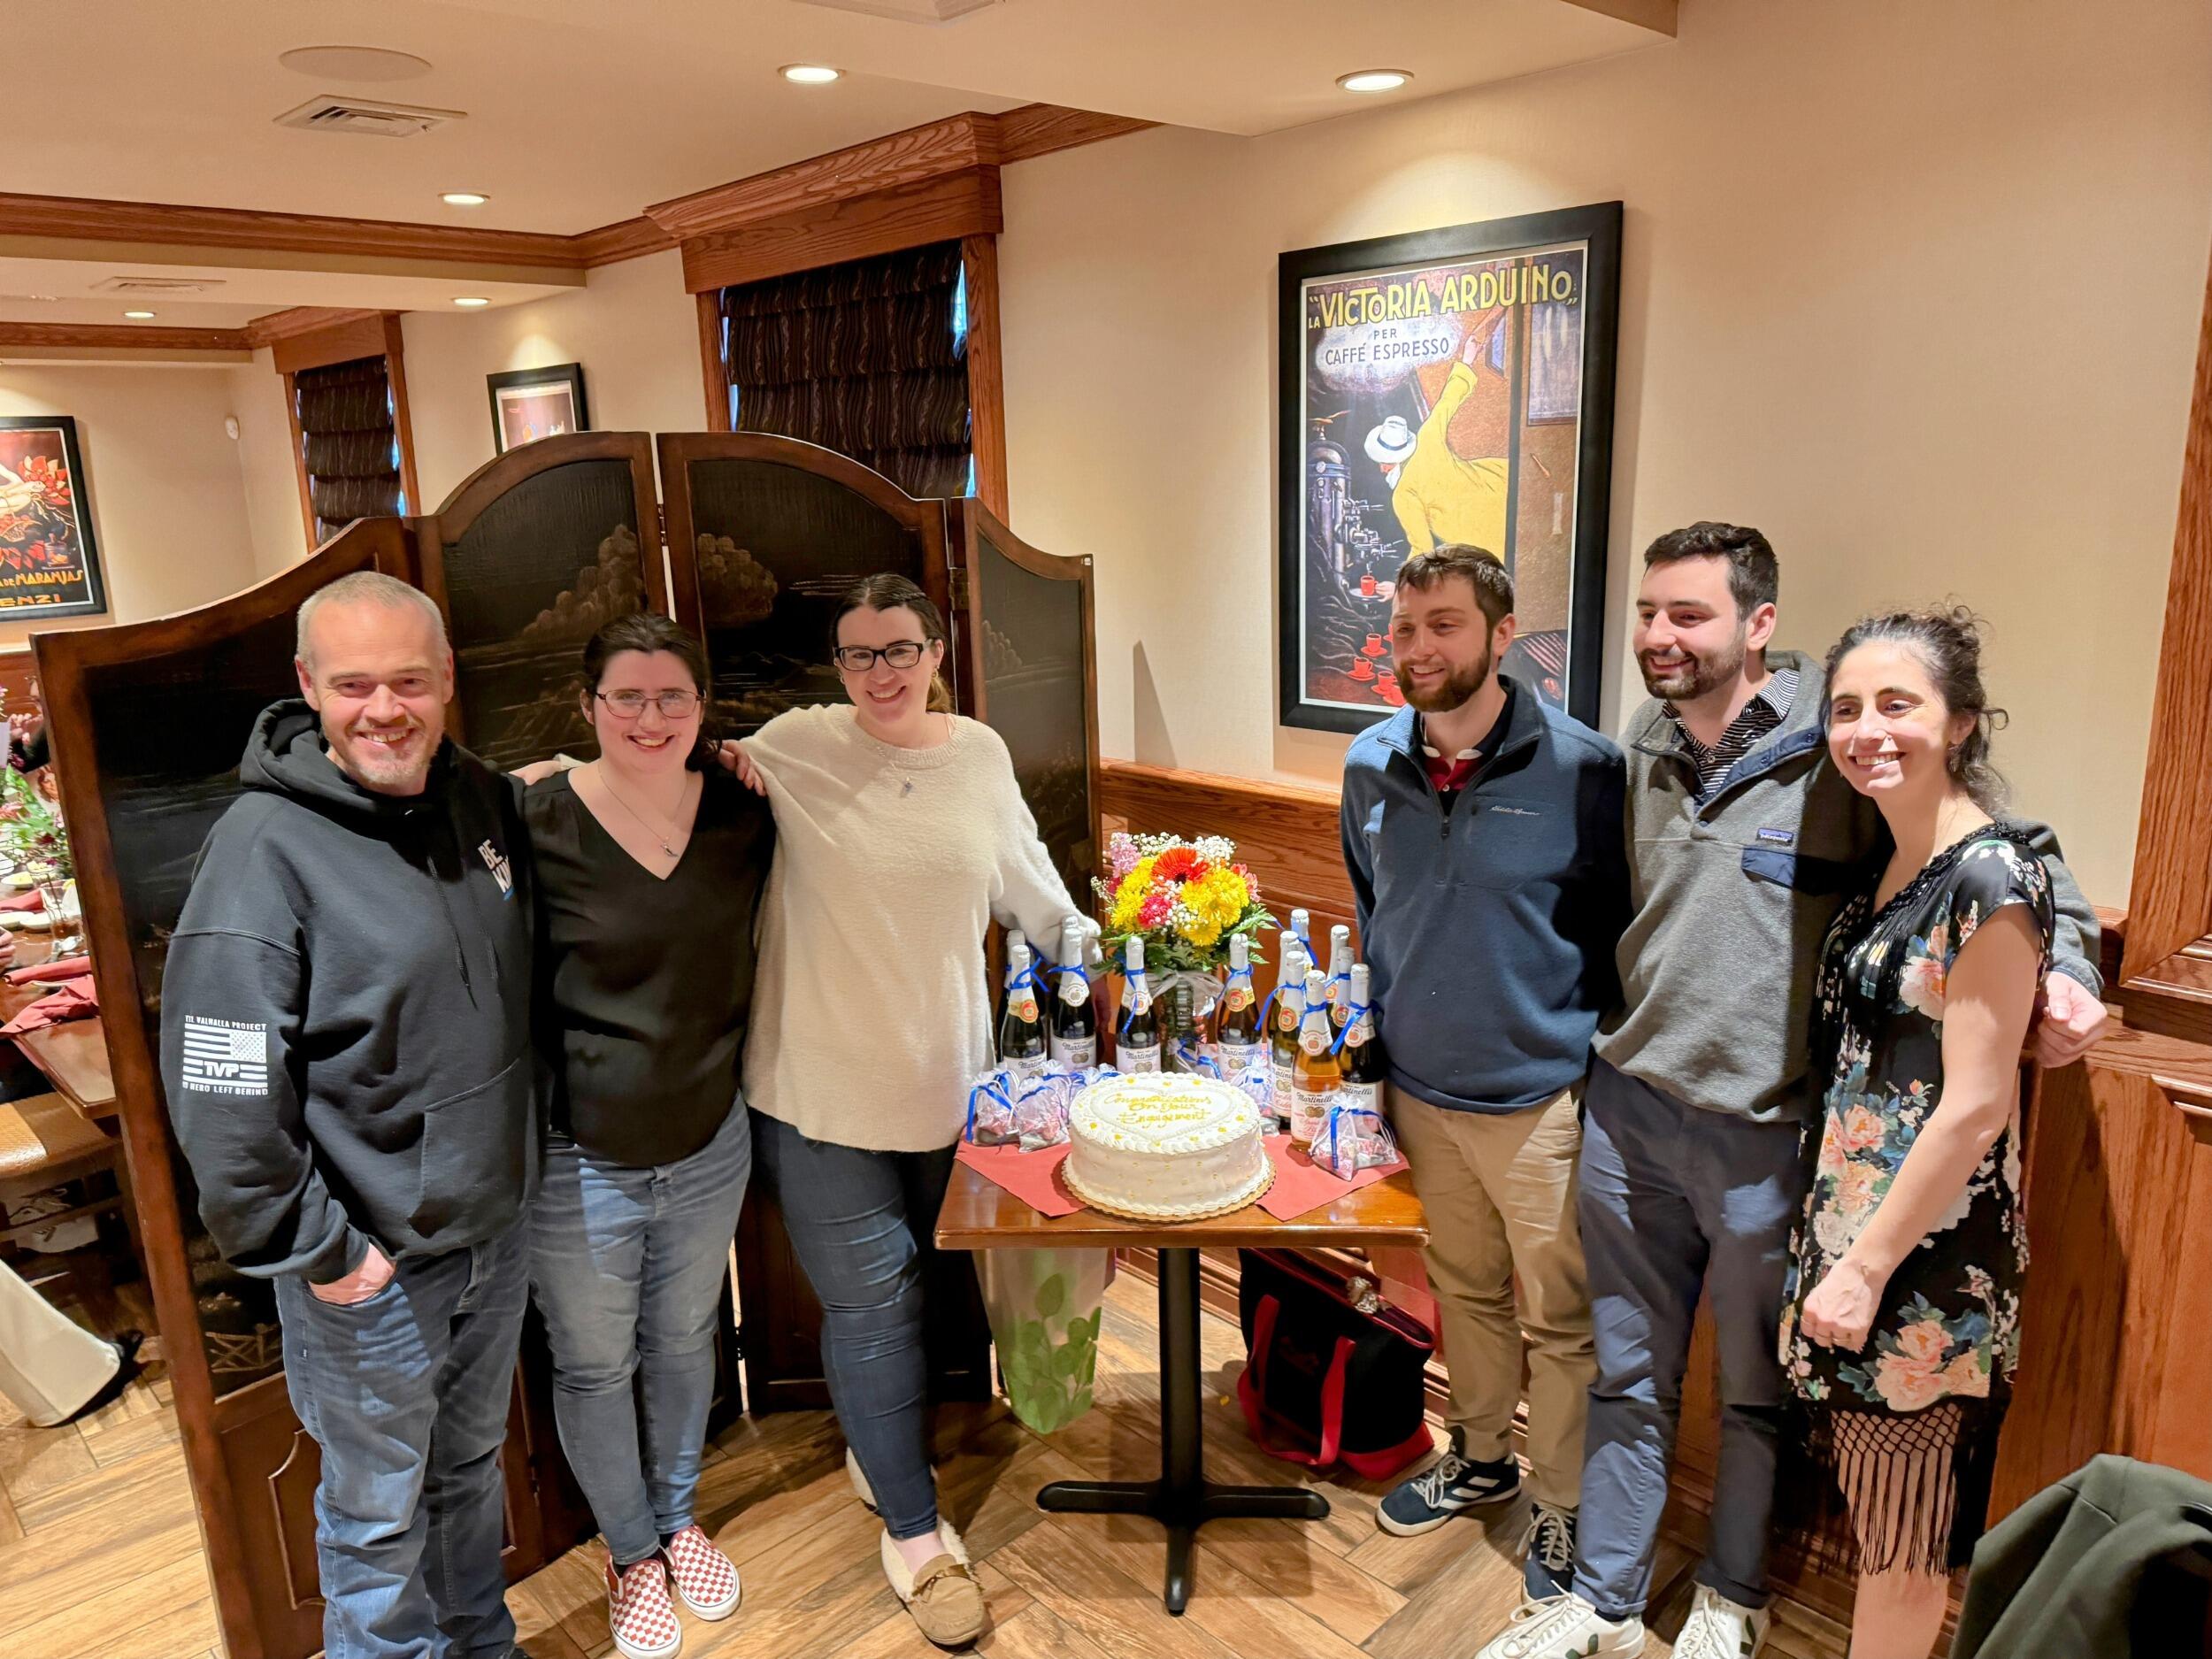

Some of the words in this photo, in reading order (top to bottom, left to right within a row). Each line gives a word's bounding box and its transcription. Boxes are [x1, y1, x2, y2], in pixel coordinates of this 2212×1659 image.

[1373, 327, 1397, 340] PER
[1373, 337, 1449, 360] ESPRESSO
[15, 569, 83, 586] NARANJAS
[196, 1017, 230, 1027] VALHALLA
[231, 1022, 266, 1031] PROJECT
[204, 1060, 240, 1078] TVP
[189, 1082, 211, 1093] HERO
